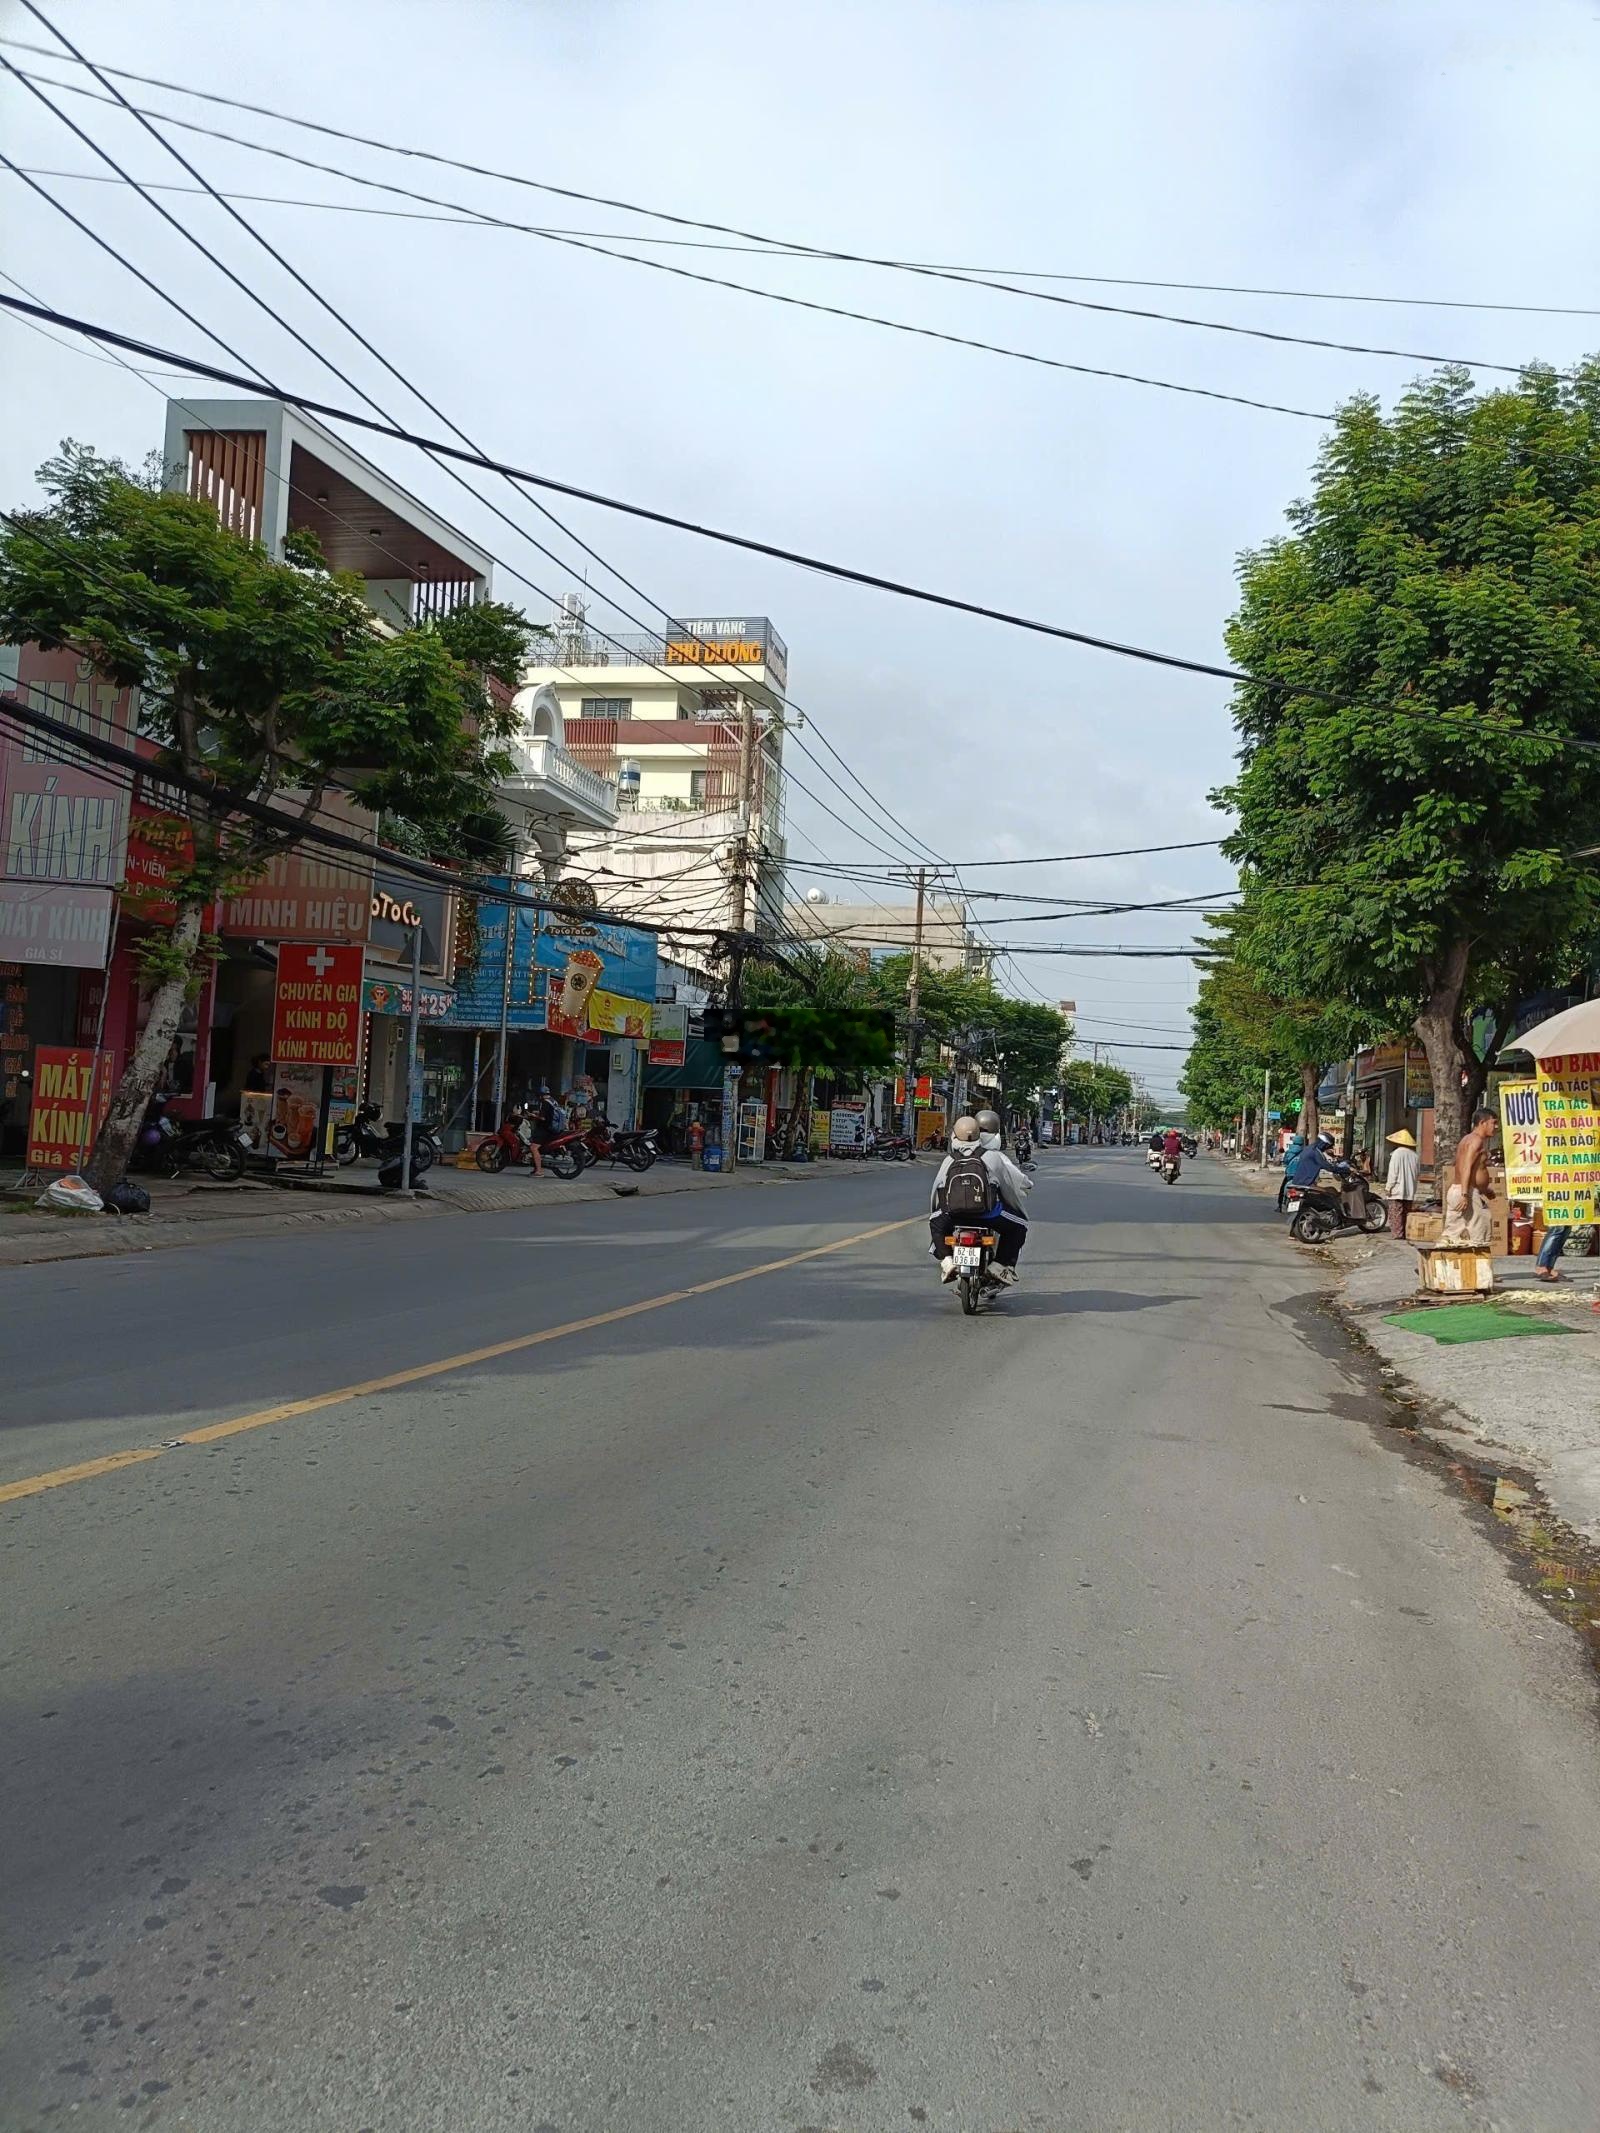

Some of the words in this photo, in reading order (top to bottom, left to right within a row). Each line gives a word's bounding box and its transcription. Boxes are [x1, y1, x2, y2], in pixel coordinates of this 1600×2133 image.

[6, 775, 117, 881] KÍNH
[229, 897, 298, 928] MINH
[305, 895, 365, 937] HIỆU
[279, 978, 332, 1001] CHUYÊN
[335, 984, 358, 1003] GIA
[285, 1005, 321, 1029] KÍNH
[326, 1007, 348, 1034] ĐỘ
[277, 1035, 307, 1058] KÍNH
[311, 1035, 353, 1060] THUỐC
[39, 1053, 93, 1101] MẮT
[31, 1102, 93, 1147] KÍNH
[30, 1148, 63, 1166] Giá
[1547, 1190, 1570, 1202] RAU
